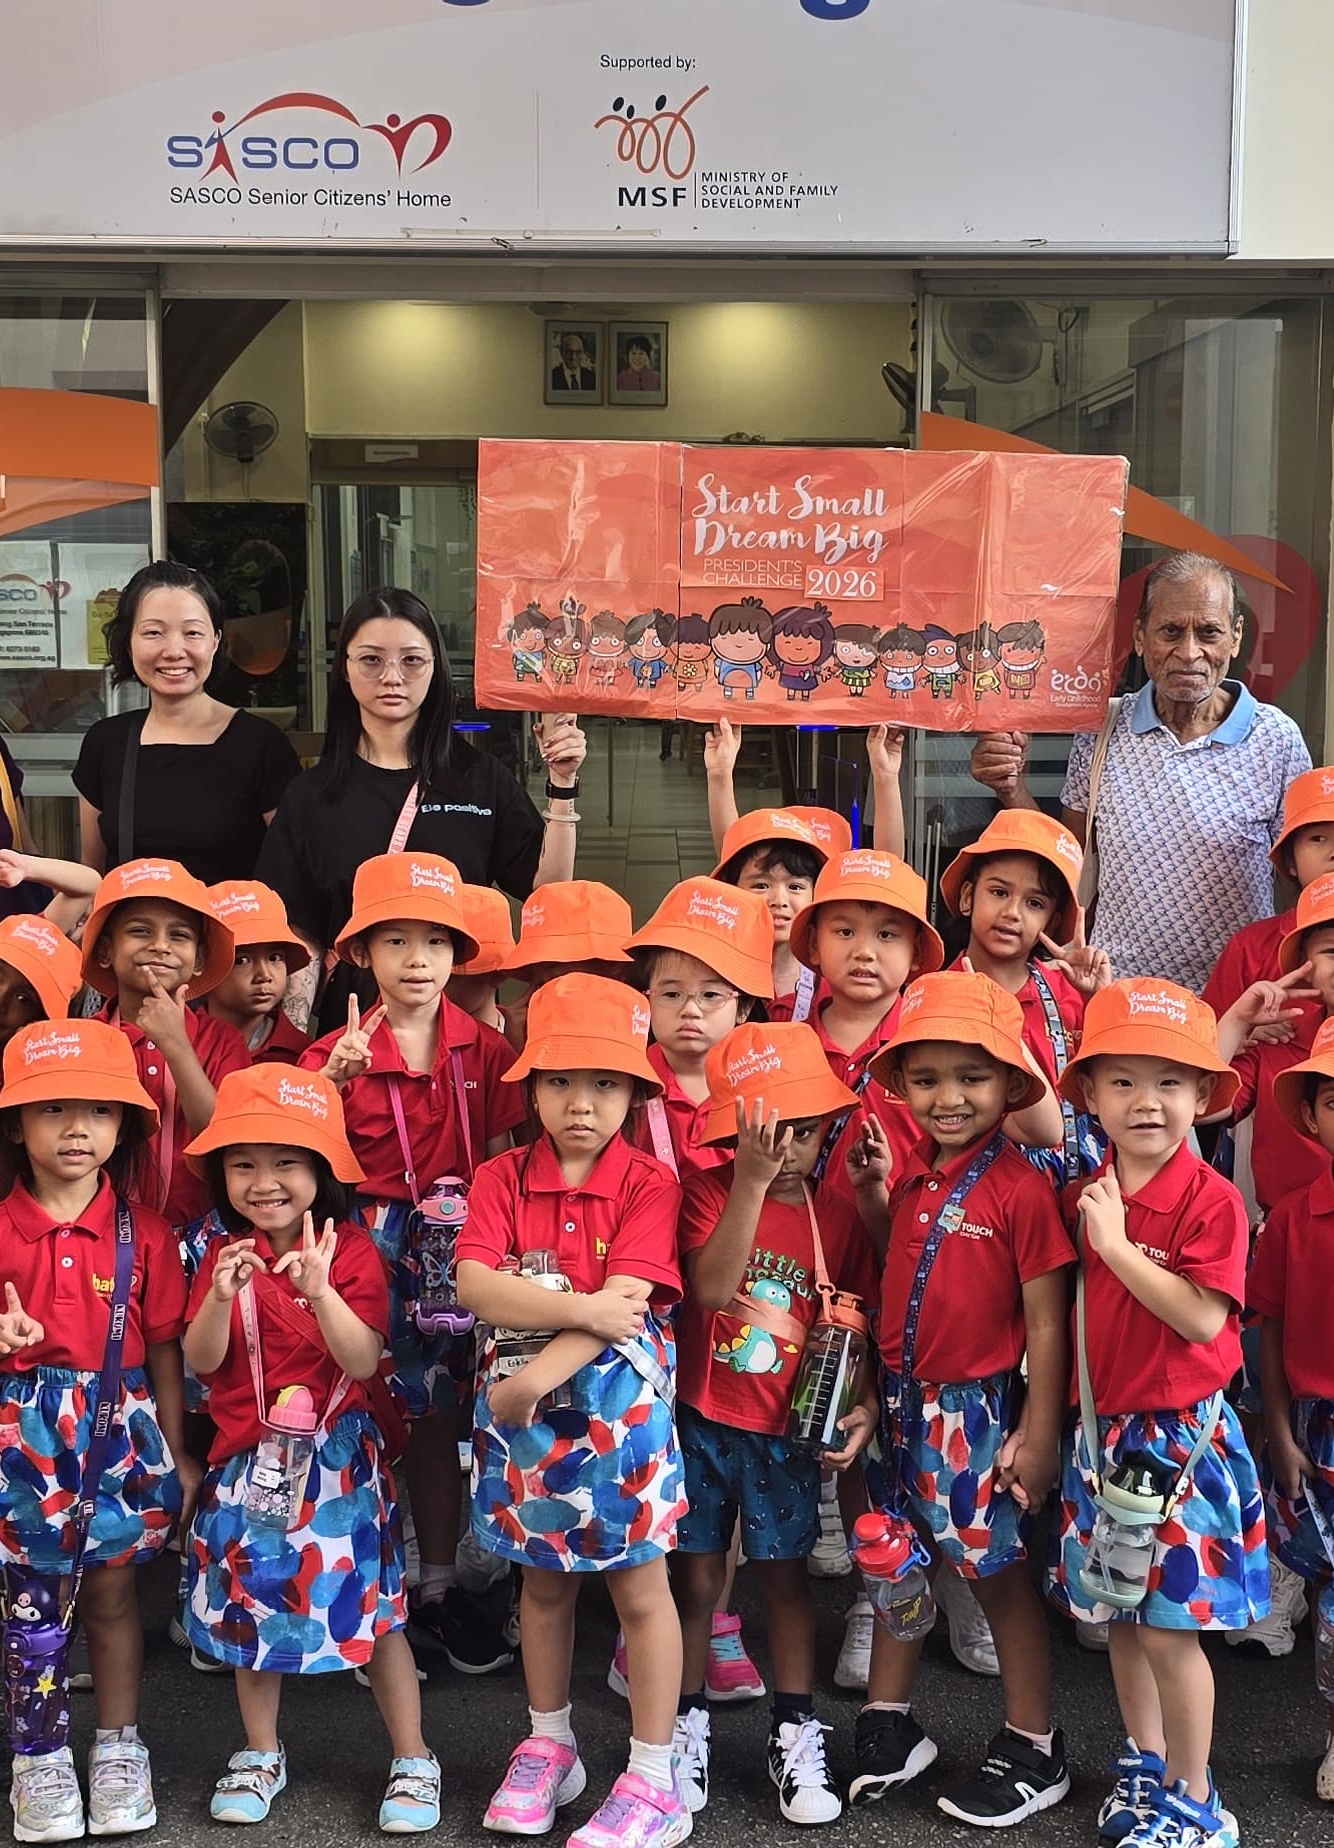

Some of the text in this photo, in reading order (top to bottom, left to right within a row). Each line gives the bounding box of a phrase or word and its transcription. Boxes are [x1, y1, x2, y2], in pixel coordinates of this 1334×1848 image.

[599, 54, 697, 71] Supported by:
[166, 130, 360, 184] SASCO
[700, 171, 789, 183] MINISTRY OF
[169, 187, 452, 207] SASCO Senior Citizens’ Home
[618, 186, 687, 208] MSF
[700, 184, 839, 196] SOCIAL AND FAMILY
[700, 198, 802, 209] DEVELOPMENT
[691, 472, 890, 520] Start Small
[693, 518, 889, 565] Dream Big
[703, 558, 803, 573] PRESIDENT'S
[702, 573, 803, 587] CHALLENGE
[806, 568, 877, 598] 2026
[1129, 991, 1188, 1011] Start Small
[1129, 1000, 1188, 1026] Dream Big
[50, 1031, 82, 1046] Small
[746, 1043, 777, 1061] Small
[725, 1056, 783, 1089] Dream Big
[278, 1077, 306, 1095] Start
[960, 1221, 994, 1239] TOUCH
[1149, 1246, 1170, 1261] TOU
[748, 1247, 807, 1283] ittle
